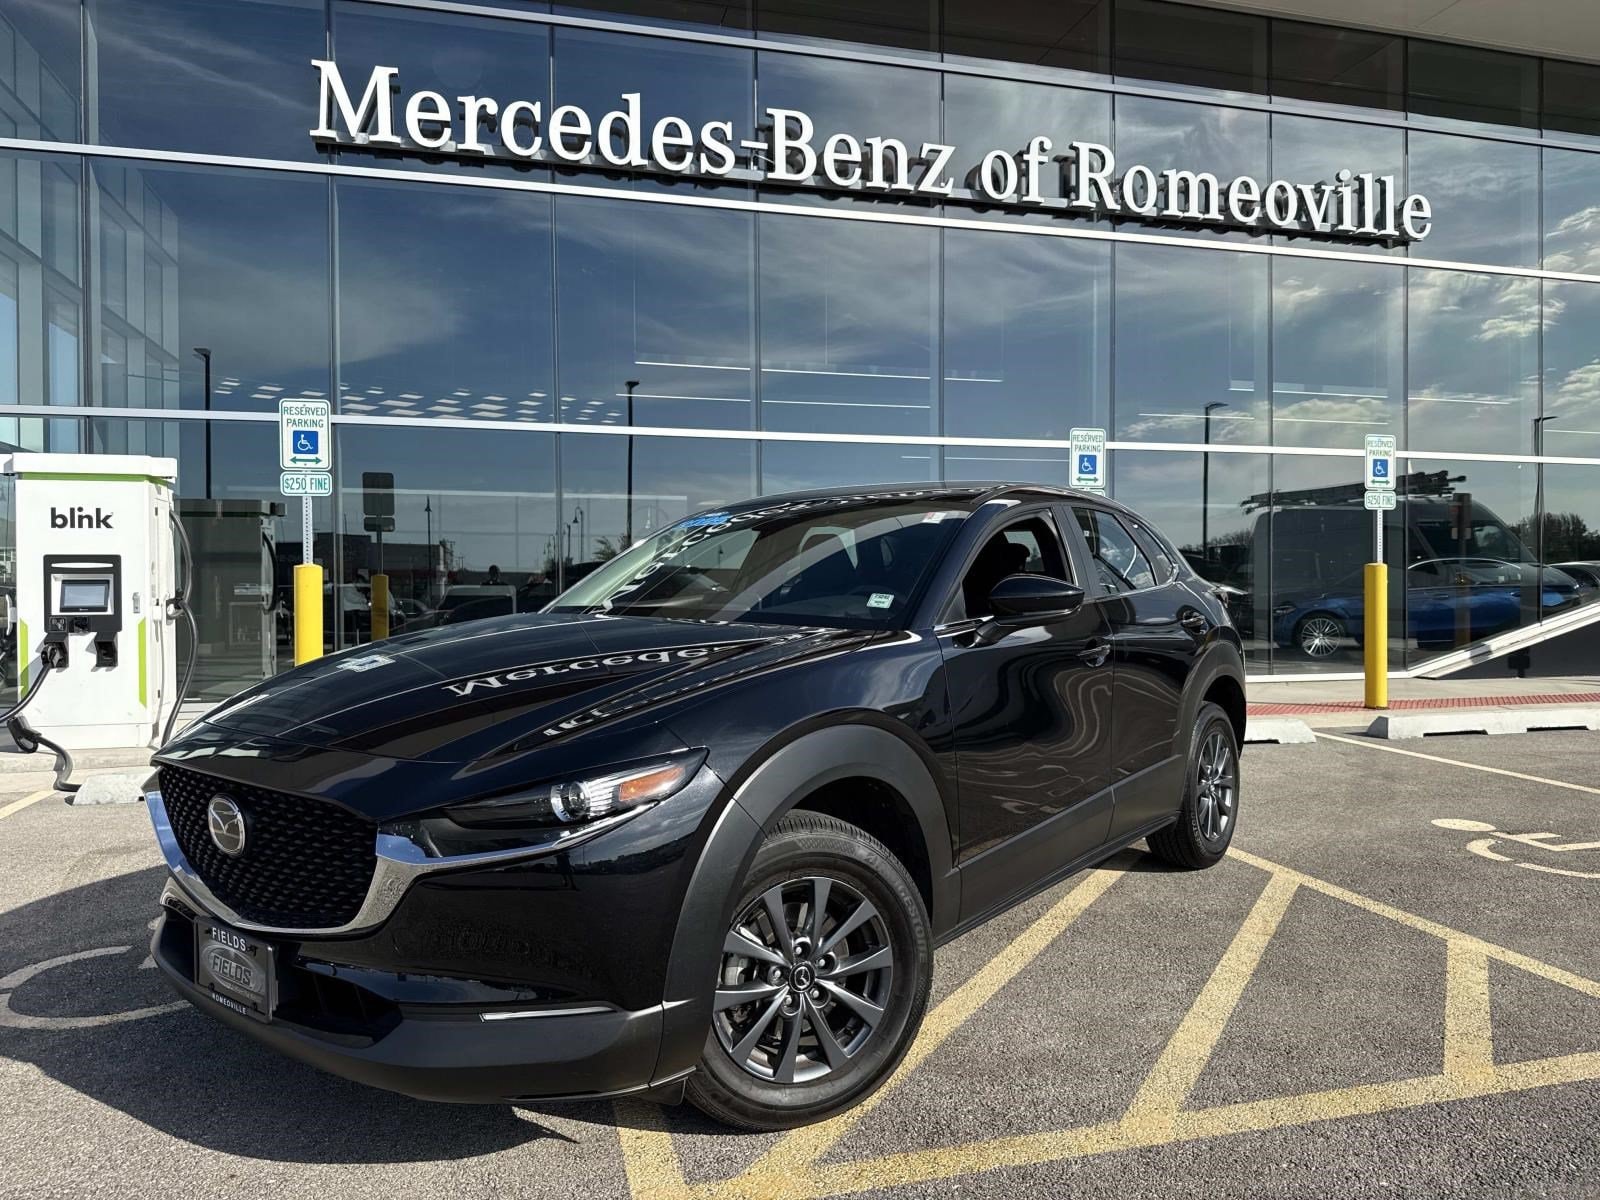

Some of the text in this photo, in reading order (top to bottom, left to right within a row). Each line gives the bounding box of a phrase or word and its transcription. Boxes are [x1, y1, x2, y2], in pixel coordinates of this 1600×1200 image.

[309, 58, 1433, 241] Mercedes-Benz of Romeoville
[283, 406, 327, 416] RESERVED
[286, 418, 324, 428] PARKING
[1072, 434, 1104, 443] RESERVED
[1074, 444, 1102, 453] PARKING
[284, 477, 328, 490] $250 FINE
[50, 506, 114, 528] blink
[211, 927, 247, 952] FIELDS
[212, 954, 252, 986] FIELDS
